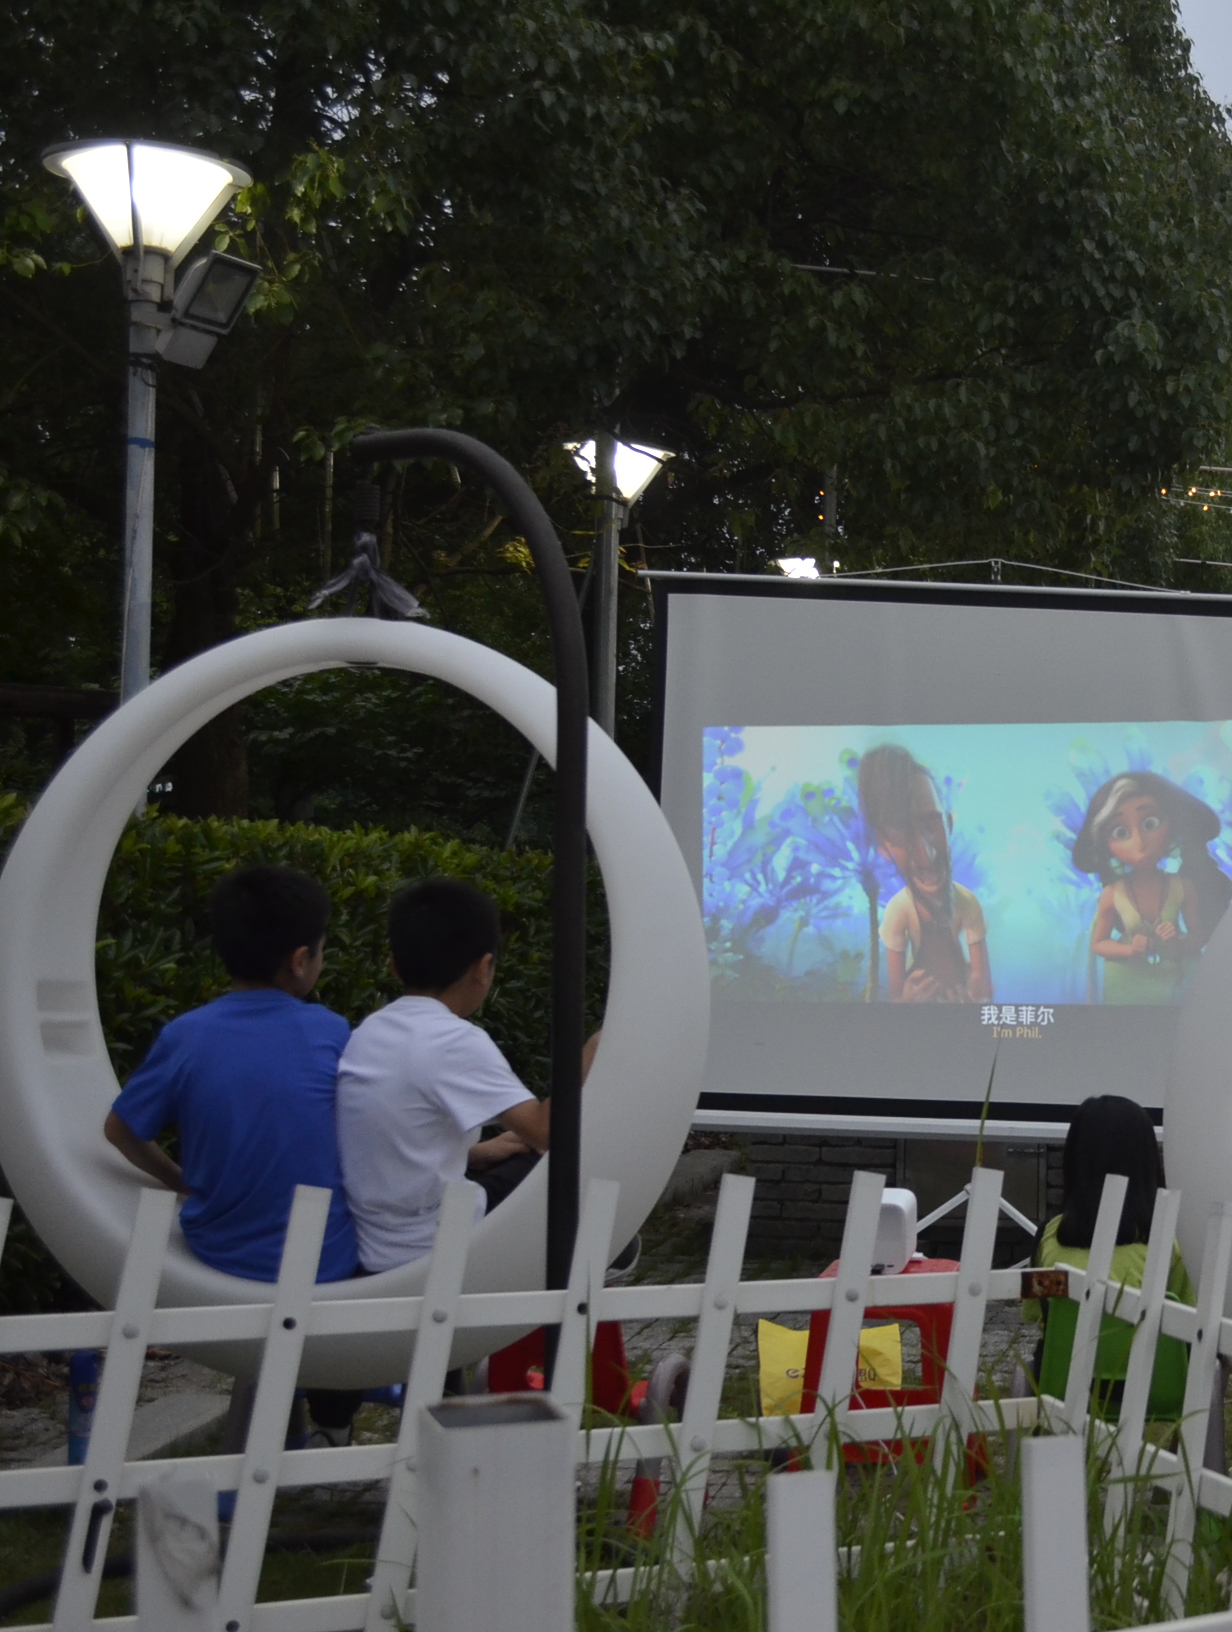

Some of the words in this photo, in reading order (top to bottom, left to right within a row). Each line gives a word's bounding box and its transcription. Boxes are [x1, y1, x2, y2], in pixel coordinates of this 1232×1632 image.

[981, 1005, 1054, 1025] 我是菲尔
[992, 1026, 1012, 1038] I'm
[1016, 1026, 1042, 1038] Phil.
